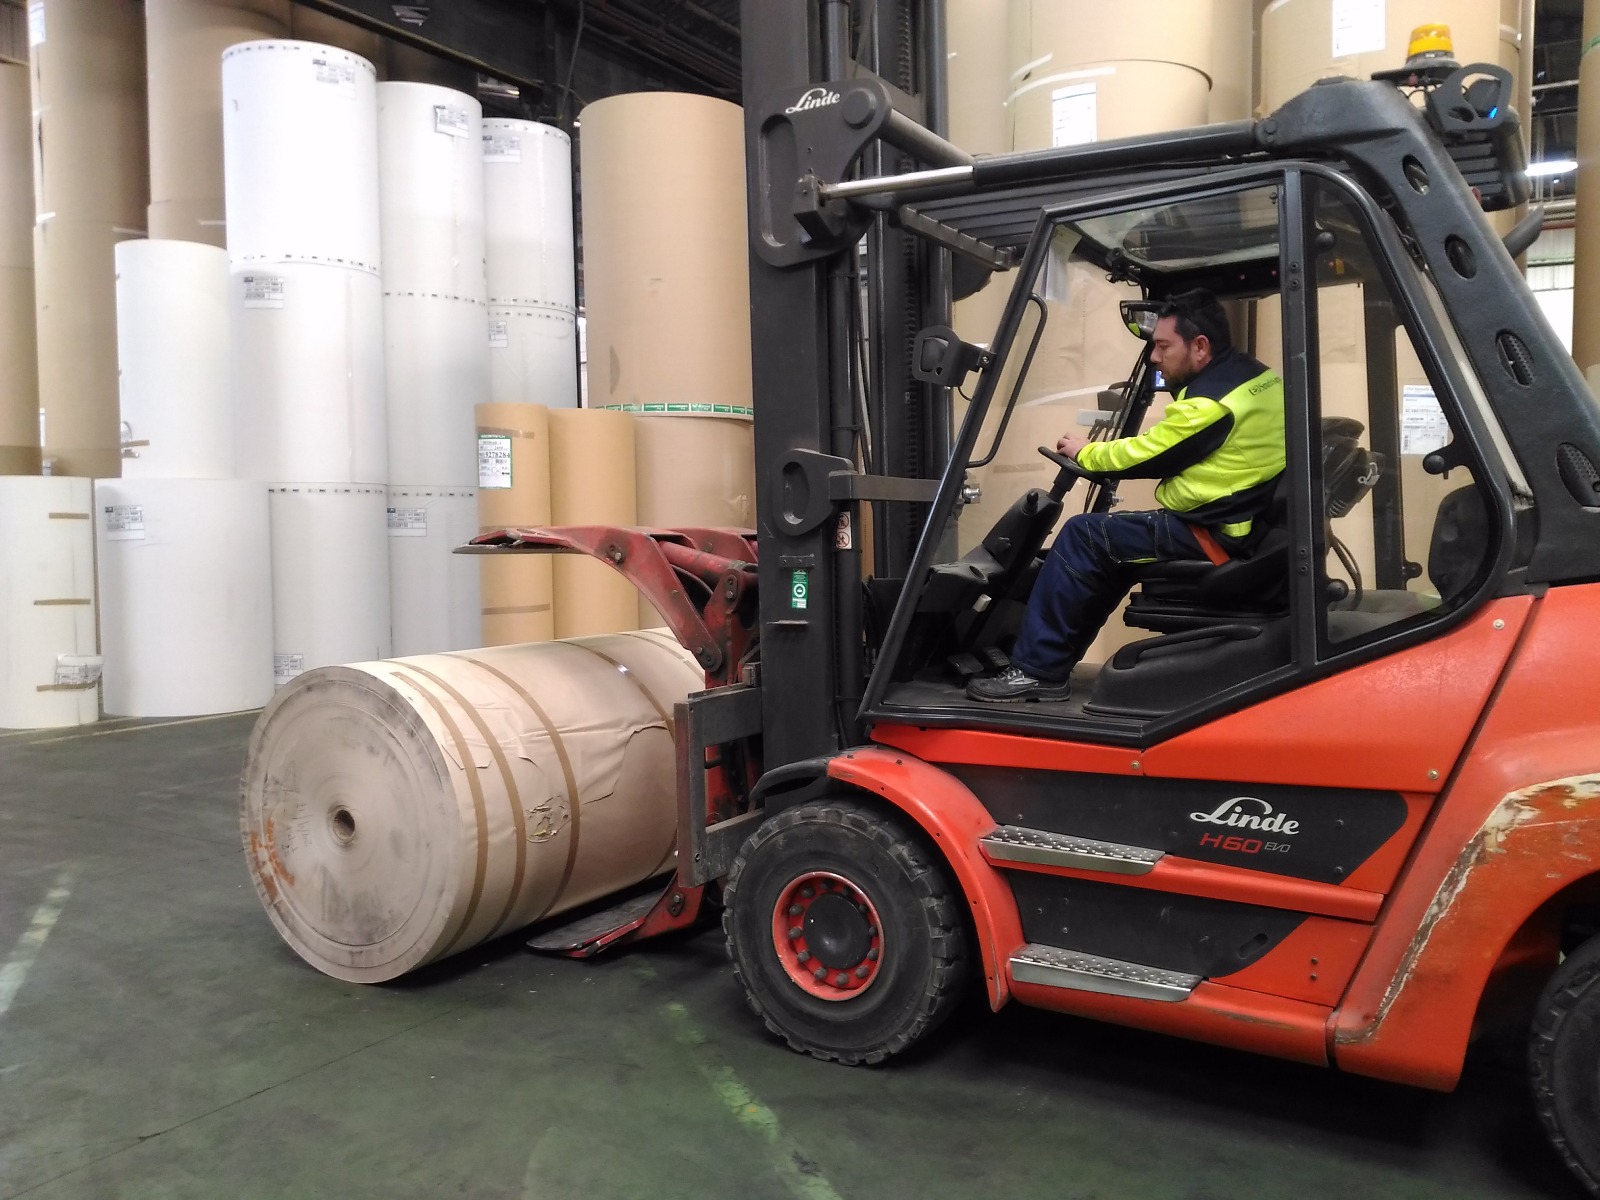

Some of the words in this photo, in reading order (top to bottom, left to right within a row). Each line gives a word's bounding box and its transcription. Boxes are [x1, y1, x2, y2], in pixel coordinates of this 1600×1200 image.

[785, 88, 840, 114] Linde
[1190, 797, 1299, 835] Linde
[1200, 832, 1263, 855] H60
